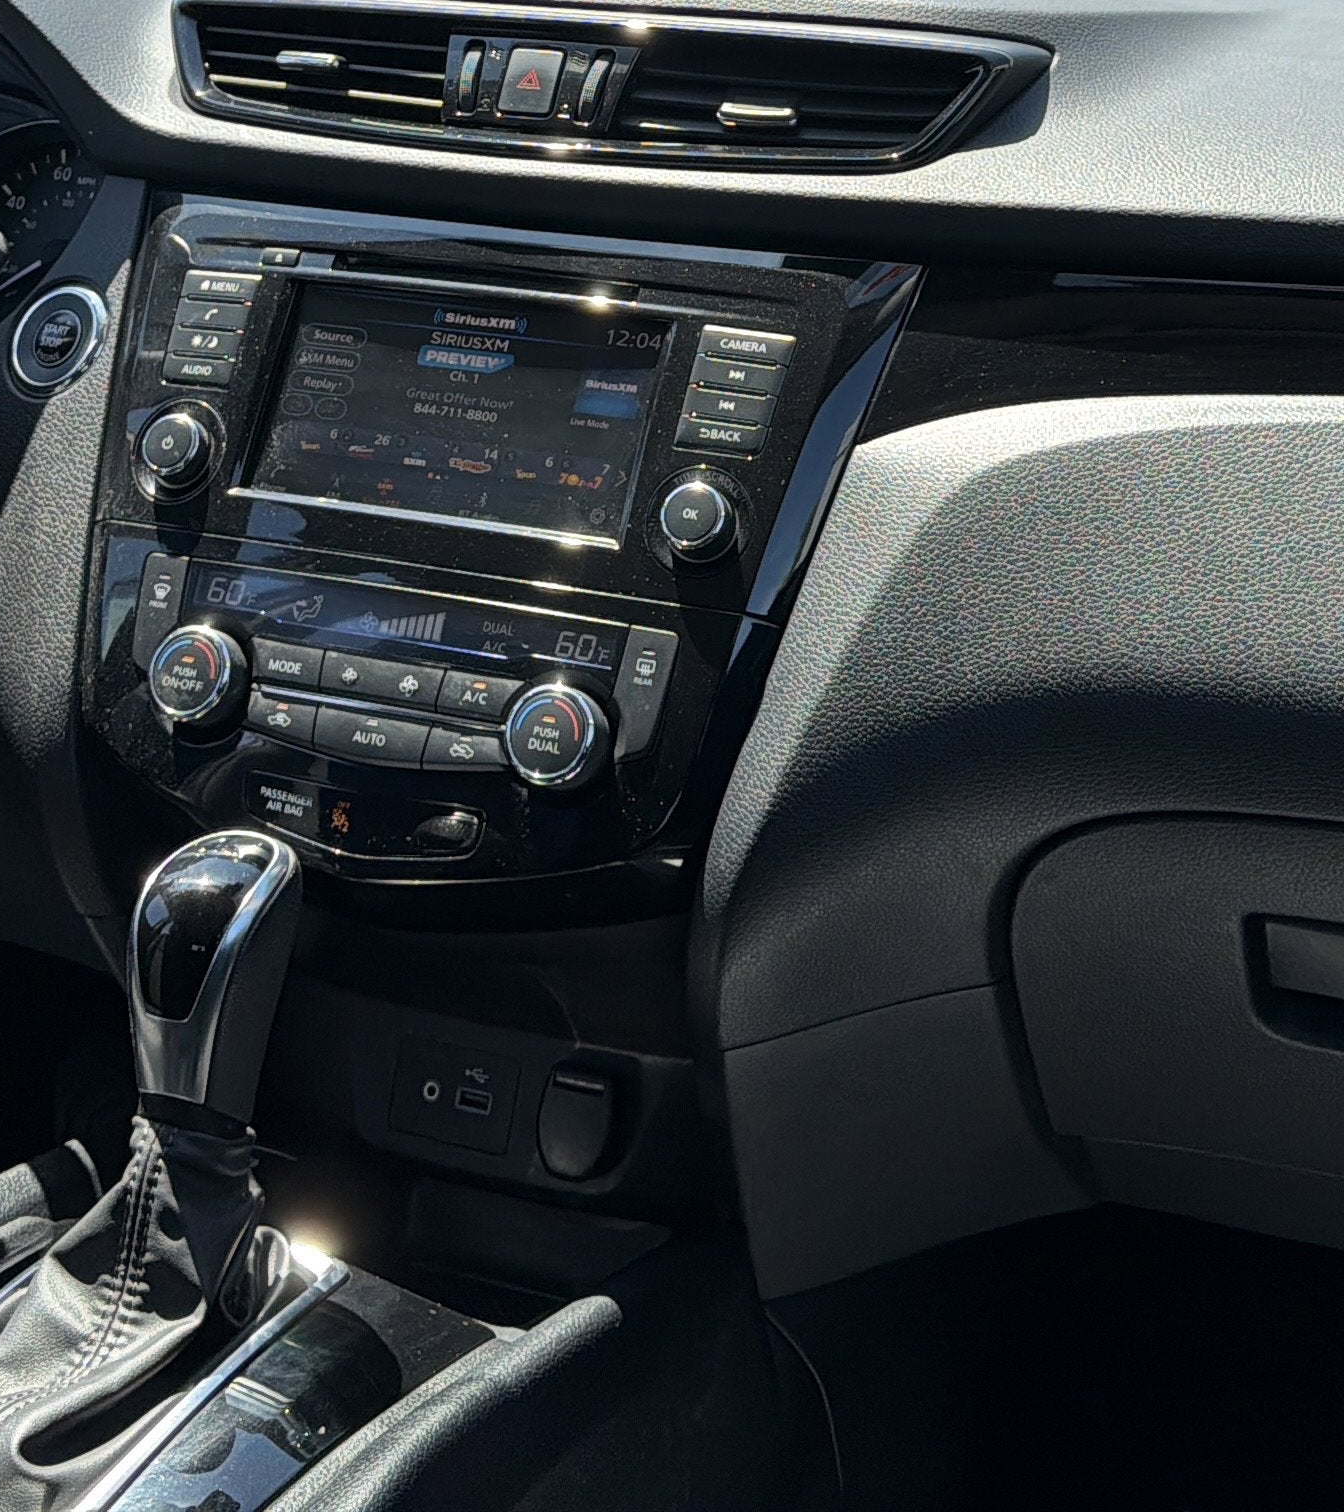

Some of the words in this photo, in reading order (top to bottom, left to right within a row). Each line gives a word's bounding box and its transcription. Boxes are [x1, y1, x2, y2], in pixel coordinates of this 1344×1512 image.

[53, 166, 72, 182] 60
[6, 195, 26, 210] 40
[211, 281, 240, 293] MENU
[43, 323, 71, 336] START
[312, 328, 355, 344] Source
[39, 337, 63, 348] STOP
[430, 332, 510, 352] SIRIUSXM
[606, 328, 663, 349] 12:04
[719, 338, 767, 353] CAMERA
[327, 354, 355, 369] Menu
[425, 350, 507, 369] PREVIEW
[181, 364, 213, 376] AUDIO
[449, 371, 470, 383] Ch.
[303, 375, 338, 392] Replay
[584, 378, 638, 393] SiriusXM
[406, 388, 441, 402] Great
[443, 392, 477, 406] Offer
[413, 401, 498, 423] 844-711-8800
[570, 417, 584, 426] Live
[586, 418, 609, 429] Mode
[330, 428, 338, 440] 6
[374, 434, 391, 446] 26
[710, 428, 741, 442] BACK
[484, 448, 498, 460] 14
[545, 457, 554, 468] 6
[682, 508, 699, 520] OK
[482, 621, 514, 637] DUAL
[482, 640, 506, 654] A/C
[173, 665, 197, 678] PUSH
[268, 658, 302, 674] MODE
[161, 674, 204, 691] ON-OFF
[633, 677, 653, 686] REAR
[462, 689, 488, 705] A/C
[352, 730, 386, 747] AUTO
[533, 726, 560, 739] PUSH
[527, 737, 560, 755] DUAL
[260, 785, 313, 808] PASSENGER
[266, 799, 285, 812] AIR
[284, 803, 304, 817] BAG
